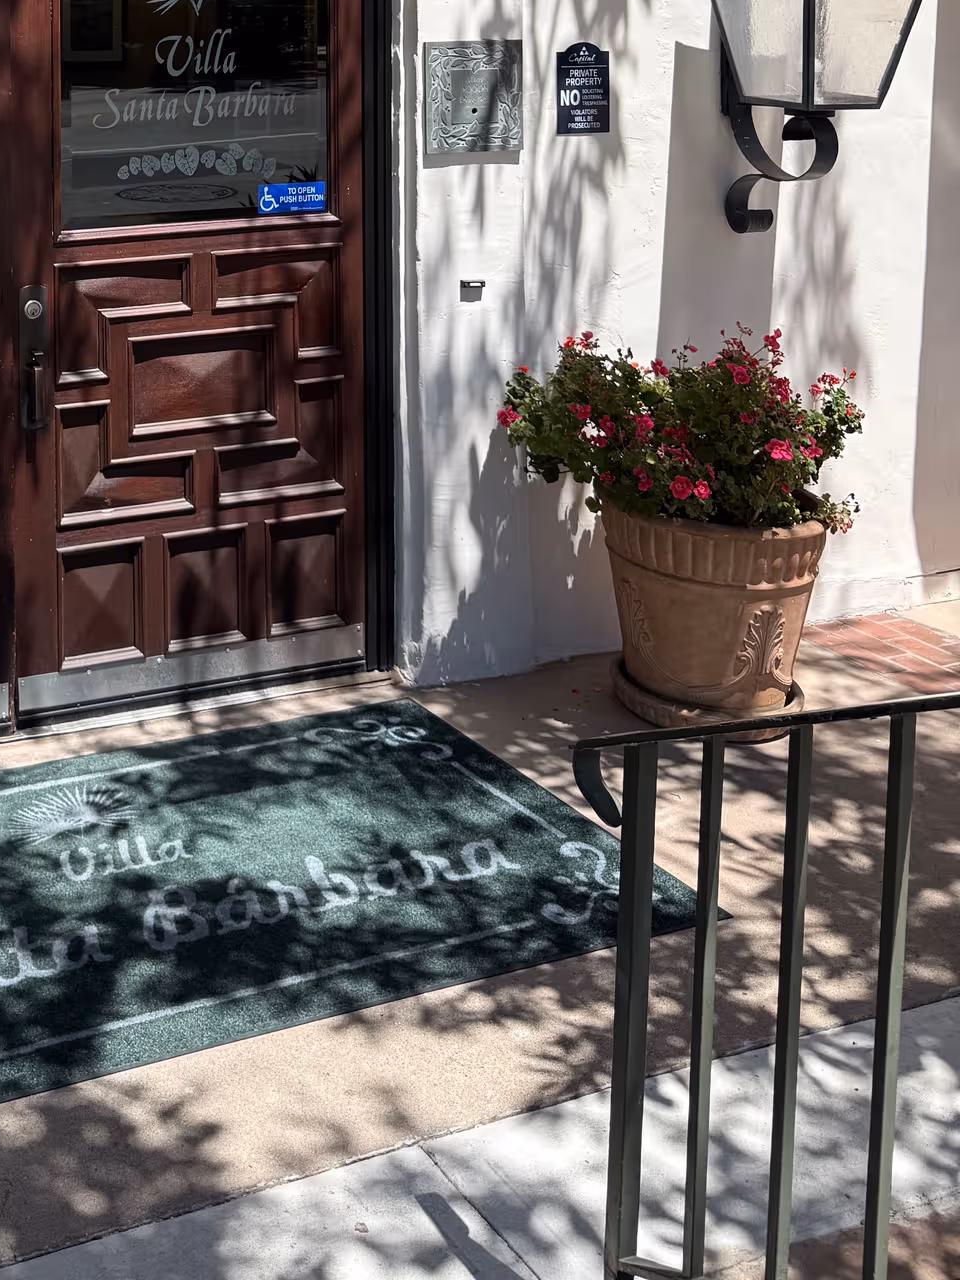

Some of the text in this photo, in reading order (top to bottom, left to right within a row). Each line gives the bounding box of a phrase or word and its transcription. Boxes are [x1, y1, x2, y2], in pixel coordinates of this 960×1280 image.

[155, 28, 237, 77] Villa
[569, 68, 598, 77] PRIVATE
[565, 77, 602, 86] PROPERTY
[93, 81, 297, 129] Santa Barbara
[560, 89, 580, 107] NO
[568, 121, 601, 129] PROSECUTED
[287, 186, 316, 195] TO OPEN
[279, 193, 324, 203] PUSH BUTTON
[58, 835, 194, 884] Villa
[140, 832, 523, 956] Barbara
